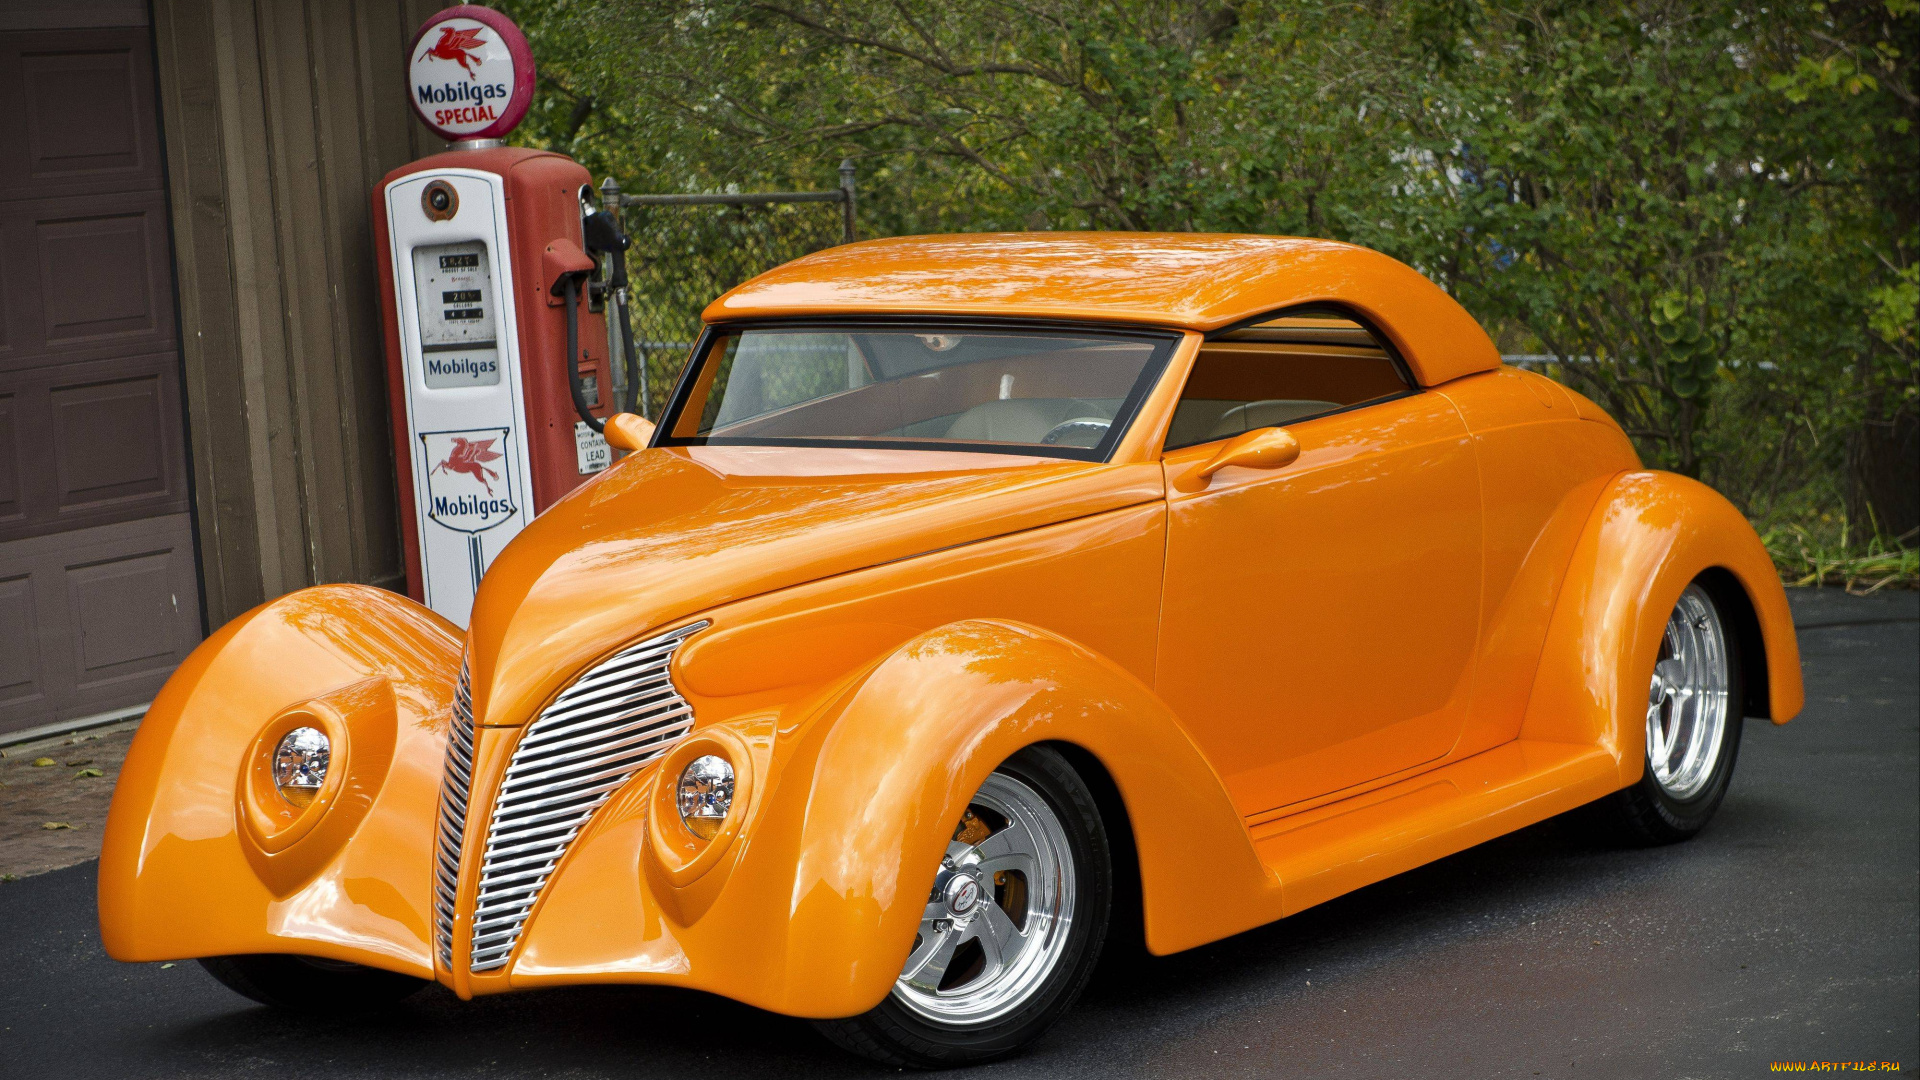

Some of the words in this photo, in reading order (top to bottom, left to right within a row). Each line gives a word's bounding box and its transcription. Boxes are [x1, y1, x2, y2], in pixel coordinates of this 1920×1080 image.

[418, 81, 507, 105] Mobilgas
[435, 105, 498, 126] SPECIAL
[428, 358, 497, 378] Mobilgas
[586, 449, 605, 462] LEAD
[435, 494, 509, 519] Mobilgas
